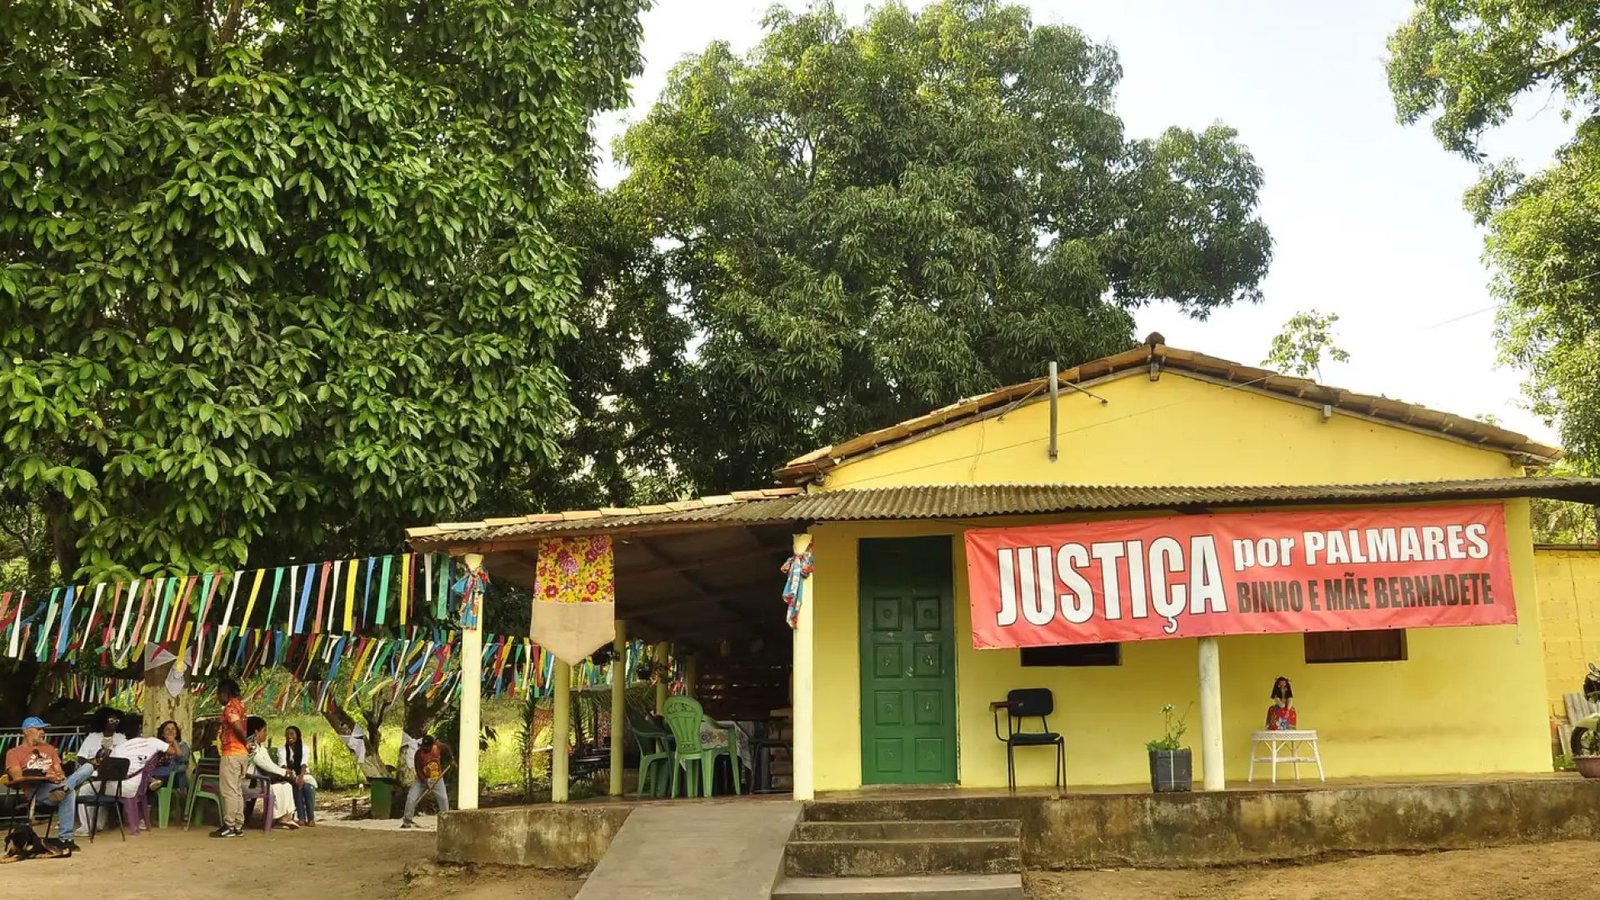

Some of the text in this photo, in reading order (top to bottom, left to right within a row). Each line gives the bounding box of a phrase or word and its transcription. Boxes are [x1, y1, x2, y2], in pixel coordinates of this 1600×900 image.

[1232, 523, 1489, 572] por PALMARES
[996, 534, 1228, 635] JUSTIÇA
[1236, 571, 1494, 613] BINHO E MÃE BERNADETE
